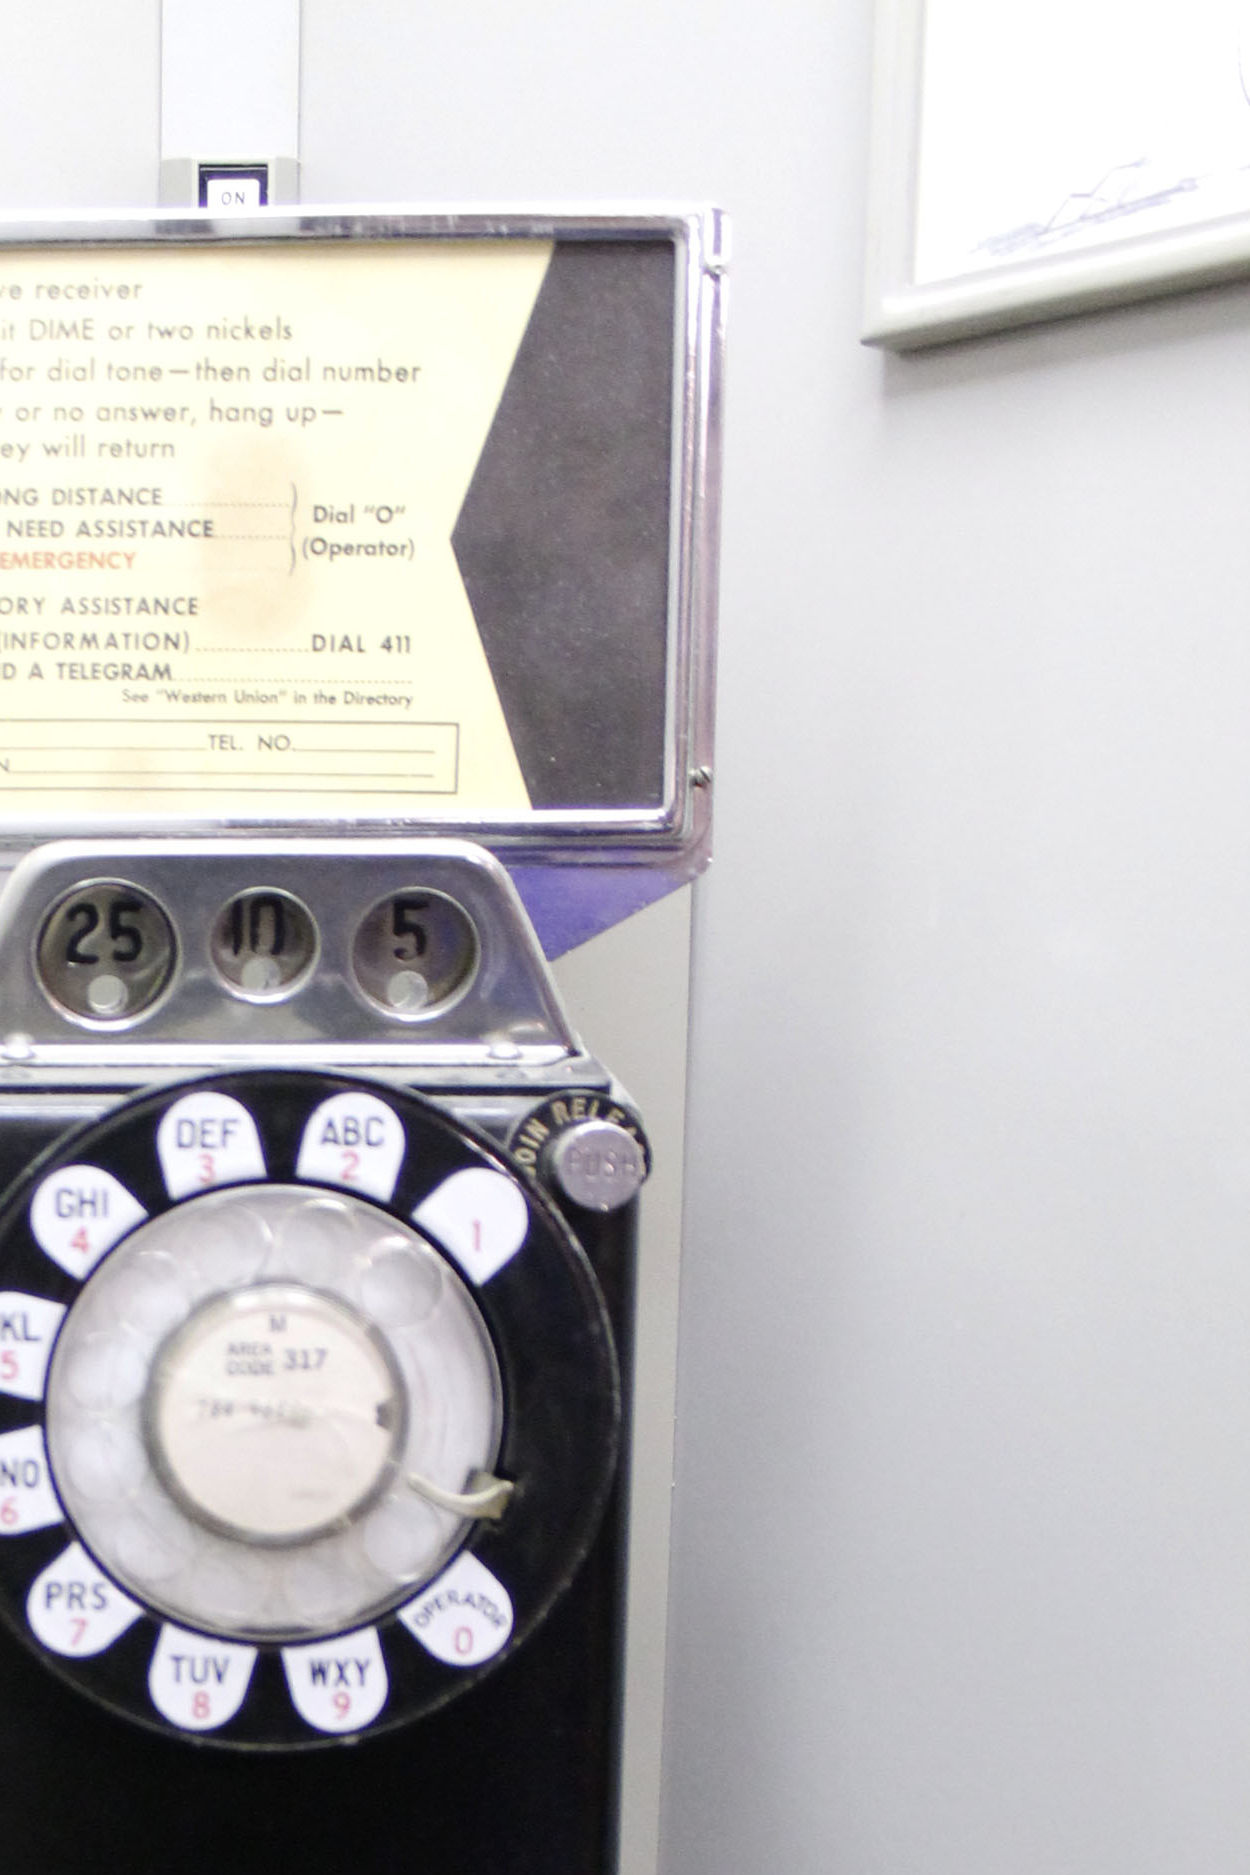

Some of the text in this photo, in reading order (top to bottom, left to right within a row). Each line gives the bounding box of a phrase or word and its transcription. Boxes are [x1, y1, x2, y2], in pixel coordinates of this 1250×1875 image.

[221, 191, 246, 205] ON
[35, 277, 142, 301] receiver
[29, 318, 95, 341] DIME
[107, 324, 134, 341] or
[148, 320, 195, 340] two
[206, 315, 294, 340] nickels
[0, 356, 36, 382] for
[47, 356, 95, 382] dial
[262, 355, 311, 382] dial
[322, 358, 422, 383] number
[15, 405, 42, 422] or
[53, 405, 84, 422] no
[96, 405, 197, 427] answer,
[209, 397, 274, 428] hang
[41, 433, 86, 458] will
[97, 438, 175, 458] return
[51, 486, 163, 507] DISTANCE
[6, 519, 65, 538] NEED
[75, 519, 215, 539] ASSISTANCE
[313, 503, 355, 524] Dial
[301, 536, 416, 562] (Operator)
[59, 596, 200, 616] ASSISTANCE
[310, 633, 367, 653] DIAL
[379, 635, 412, 654] 411
[27, 662, 45, 681] A
[55, 662, 174, 682] TELEGRAM
[121, 688, 414, 710] See "Western Union" in the Directory
[207, 733, 244, 751] TEL.
[65, 900, 145, 965] 25
[230, 896, 285, 957] 10
[392, 898, 430, 961] 5
[174, 1118, 241, 1152] DEF
[318, 1116, 386, 1149] ABC
[195, 1153, 217, 1187] 3
[339, 1151, 361, 1183] 2
[53, 1186, 110, 1220] GHI
[68, 1225, 90, 1257] 4
[470, 1219, 484, 1254] 1
[283, 1347, 329, 1371] 317
[43, 1580, 109, 1613] PRS
[412, 1588, 508, 1630] OPERATOR
[68, 1617, 89, 1648] 7
[453, 1625, 474, 1656] 0
[170, 1654, 232, 1688] TUV
[308, 1656, 373, 1689] WXY
[190, 1689, 212, 1721] 8
[331, 1690, 352, 1721] 9
